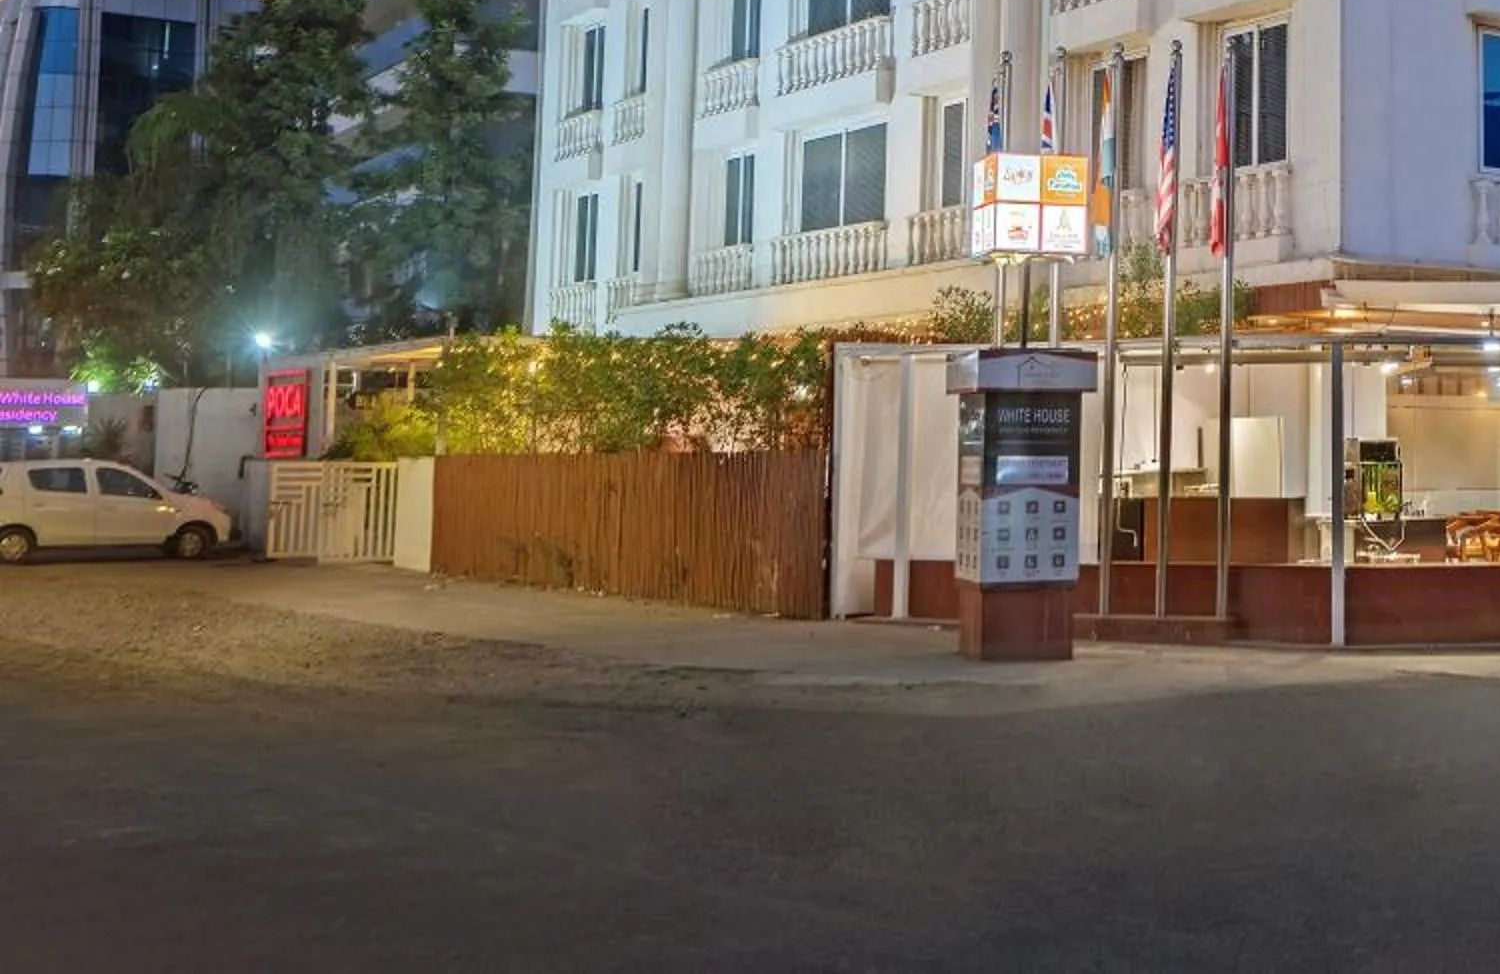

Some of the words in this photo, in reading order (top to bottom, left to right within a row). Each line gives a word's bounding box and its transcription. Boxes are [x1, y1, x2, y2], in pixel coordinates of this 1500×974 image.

[0, 390, 41, 405] White
[43, 391, 85, 405] House
[997, 408, 1032, 423] WHITE
[1033, 408, 1071, 423] HOUSE
